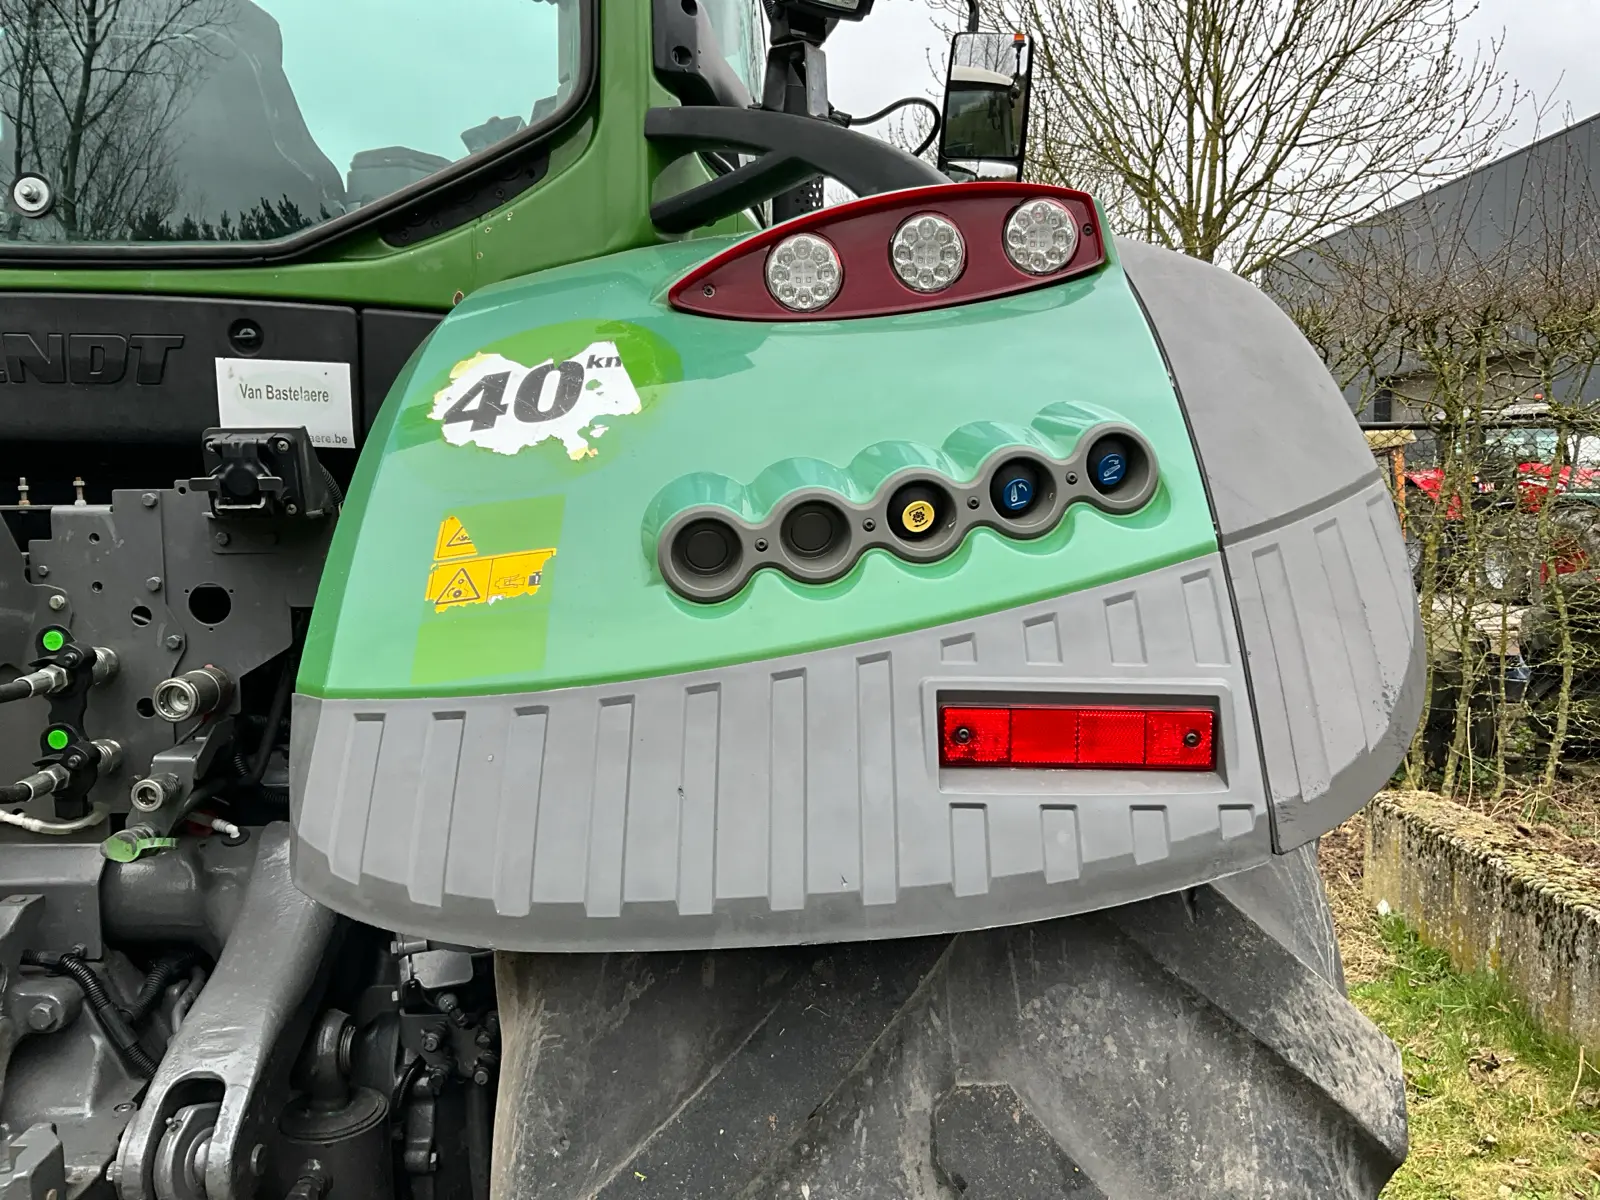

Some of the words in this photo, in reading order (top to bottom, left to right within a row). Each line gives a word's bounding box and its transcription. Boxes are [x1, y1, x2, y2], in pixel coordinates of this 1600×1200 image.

[0, 332, 185, 386] NDT
[239, 383, 262, 400] Van
[265, 384, 330, 403] Bastelaere
[442, 360, 586, 433] 40
